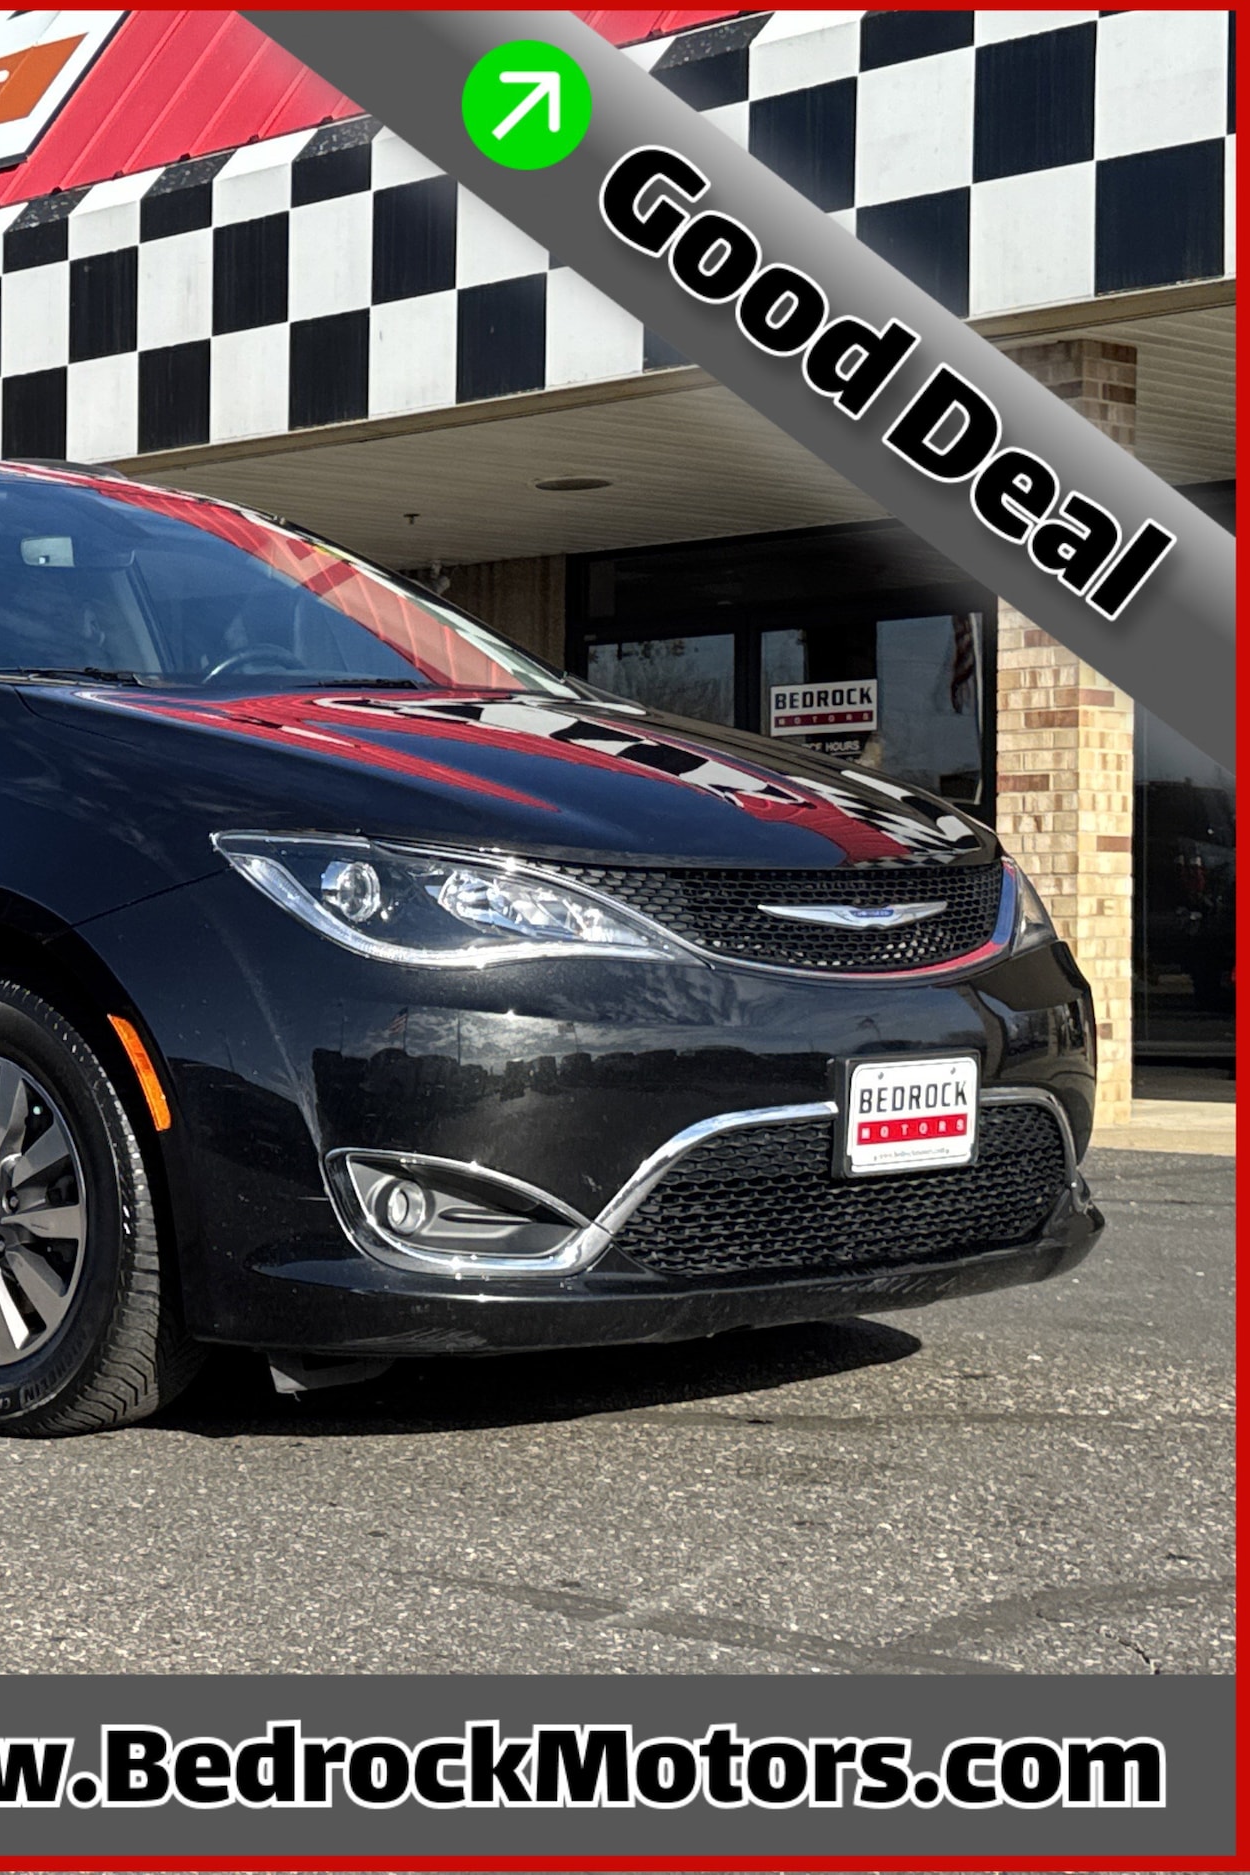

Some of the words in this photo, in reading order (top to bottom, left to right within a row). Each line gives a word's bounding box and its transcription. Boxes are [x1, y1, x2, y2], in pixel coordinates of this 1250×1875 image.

[774, 687, 872, 710] BEDROCK
[778, 713, 869, 725] MOTORS
[825, 741, 860, 752] HOURS
[859, 1081, 967, 1114] BEDROCK
[861, 1118, 964, 1139] MOTORS
